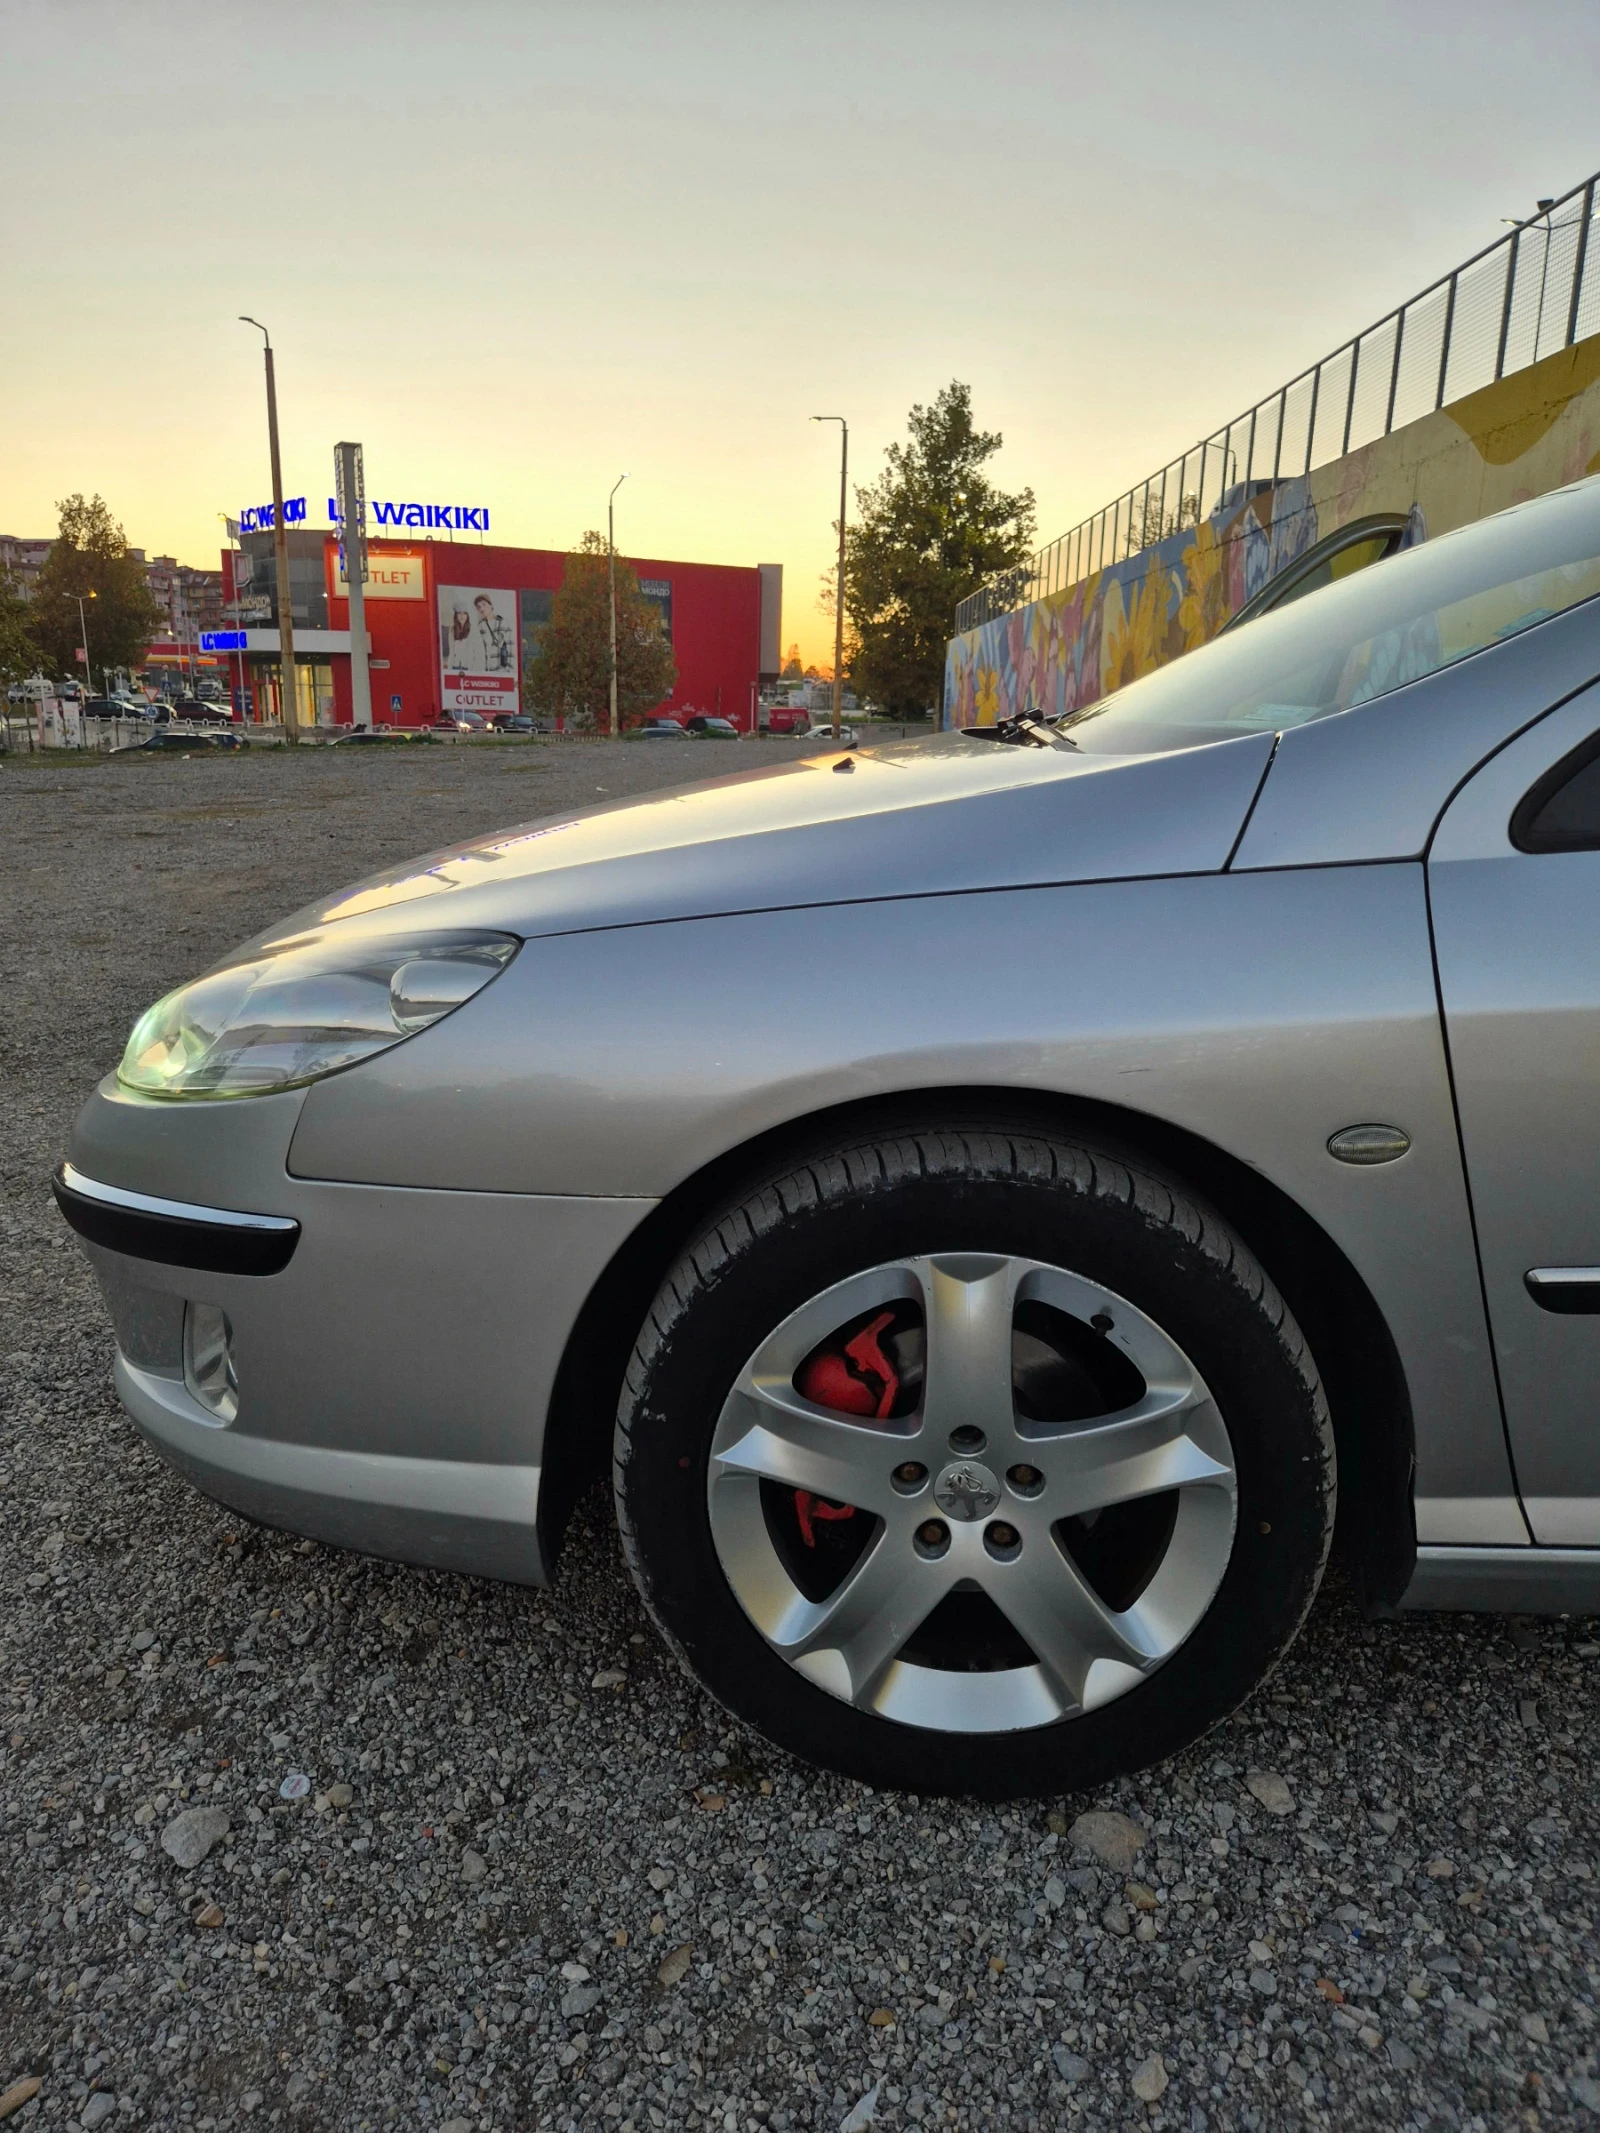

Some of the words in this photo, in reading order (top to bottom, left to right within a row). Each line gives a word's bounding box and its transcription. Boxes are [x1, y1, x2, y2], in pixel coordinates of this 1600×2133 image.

[241, 508, 256, 532] LC
[372, 501, 489, 530] WaIKIKI
[642, 588, 670, 597] МОНДО
[456, 695, 504, 706] OUTLET
